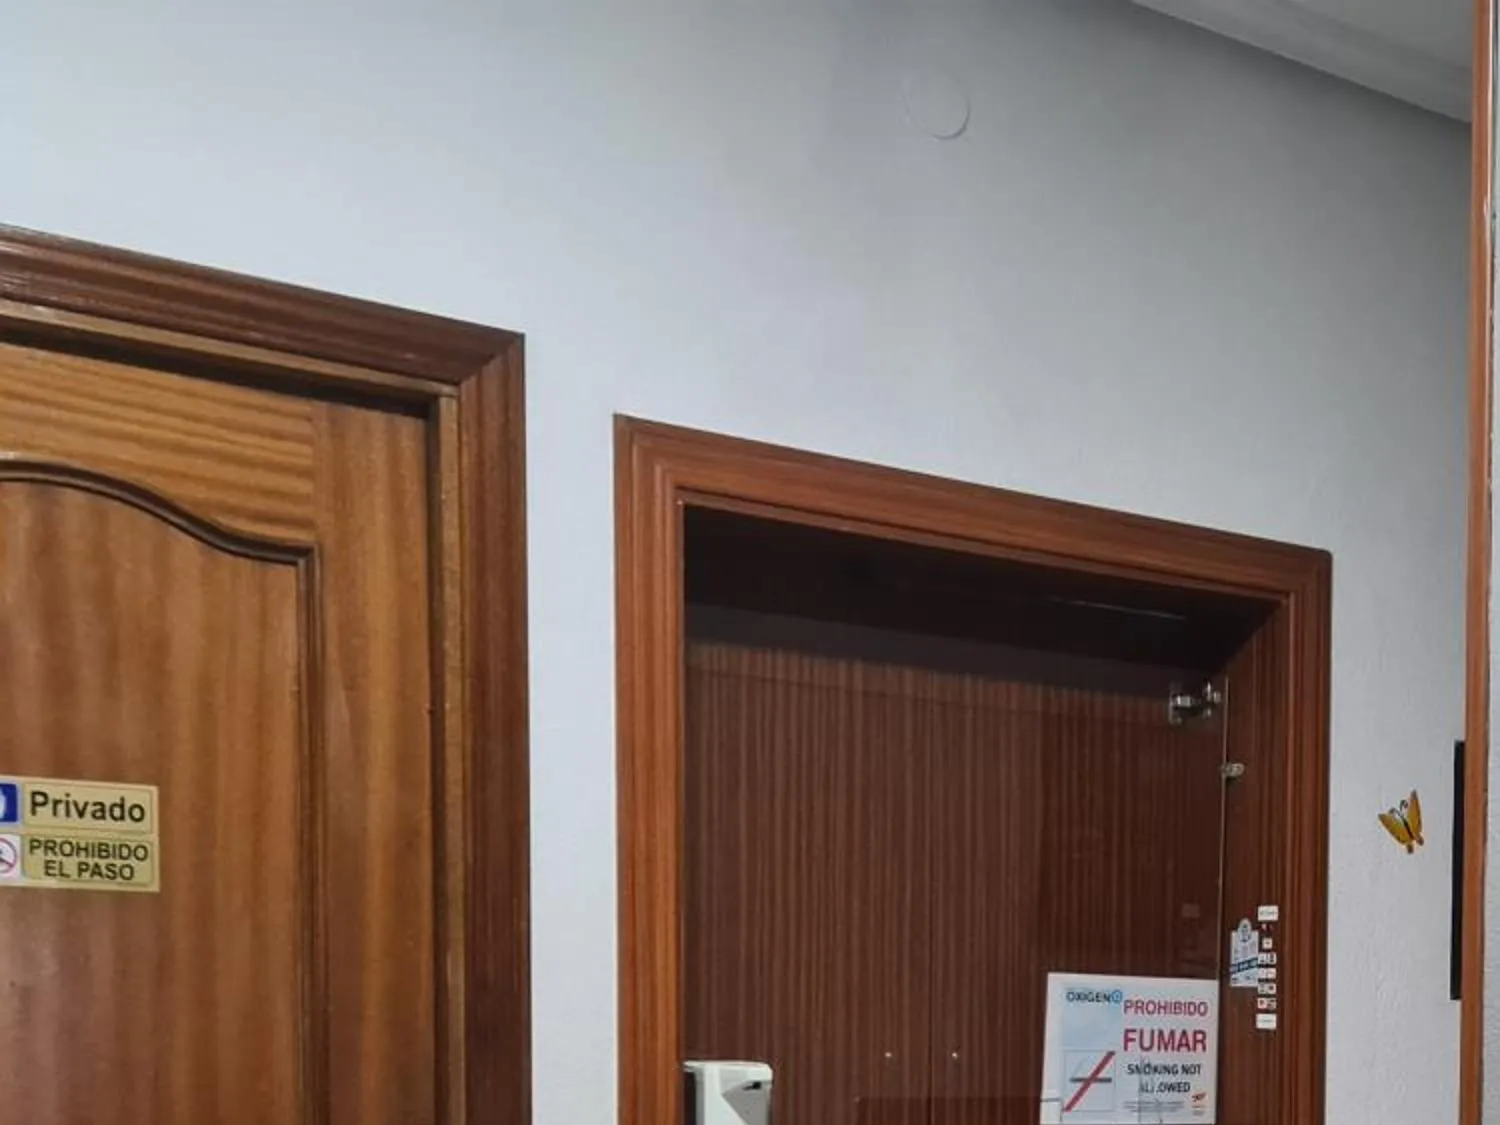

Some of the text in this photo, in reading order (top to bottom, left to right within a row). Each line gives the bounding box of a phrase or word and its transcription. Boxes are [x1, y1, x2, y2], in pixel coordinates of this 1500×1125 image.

[30, 791, 146, 822] Privado
[29, 838, 149, 861] PROHIBIDO
[44, 860, 135, 880] EL PASO
[1123, 999, 1209, 1017] PROHIBIDO
[1123, 1028, 1207, 1053] FUMAR
[1181, 1063, 1202, 1075] NOT
